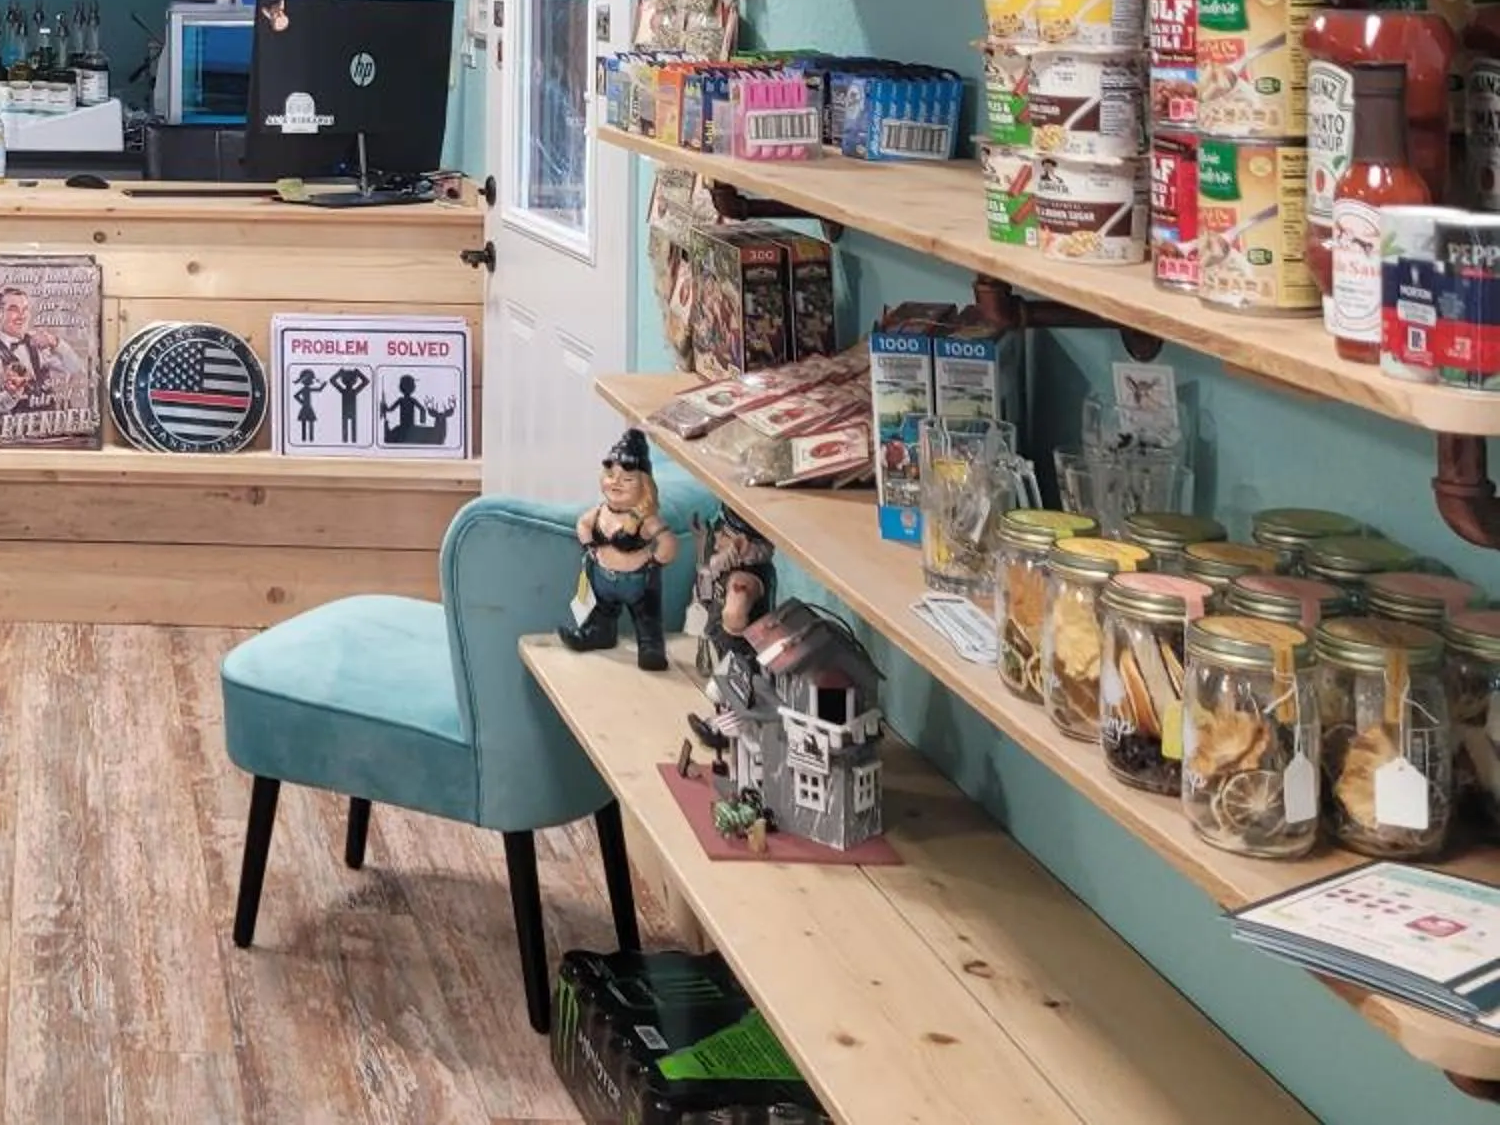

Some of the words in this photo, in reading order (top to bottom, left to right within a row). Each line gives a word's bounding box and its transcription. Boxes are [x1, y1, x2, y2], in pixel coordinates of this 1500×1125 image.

[352, 53, 376, 86] hp
[1449, 243, 1500, 267] PEPP
[292, 339, 368, 355] PROBLEM
[387, 340, 449, 357] SOLVED
[878, 337, 920, 352] 1000
[943, 342, 986, 357] 1000
